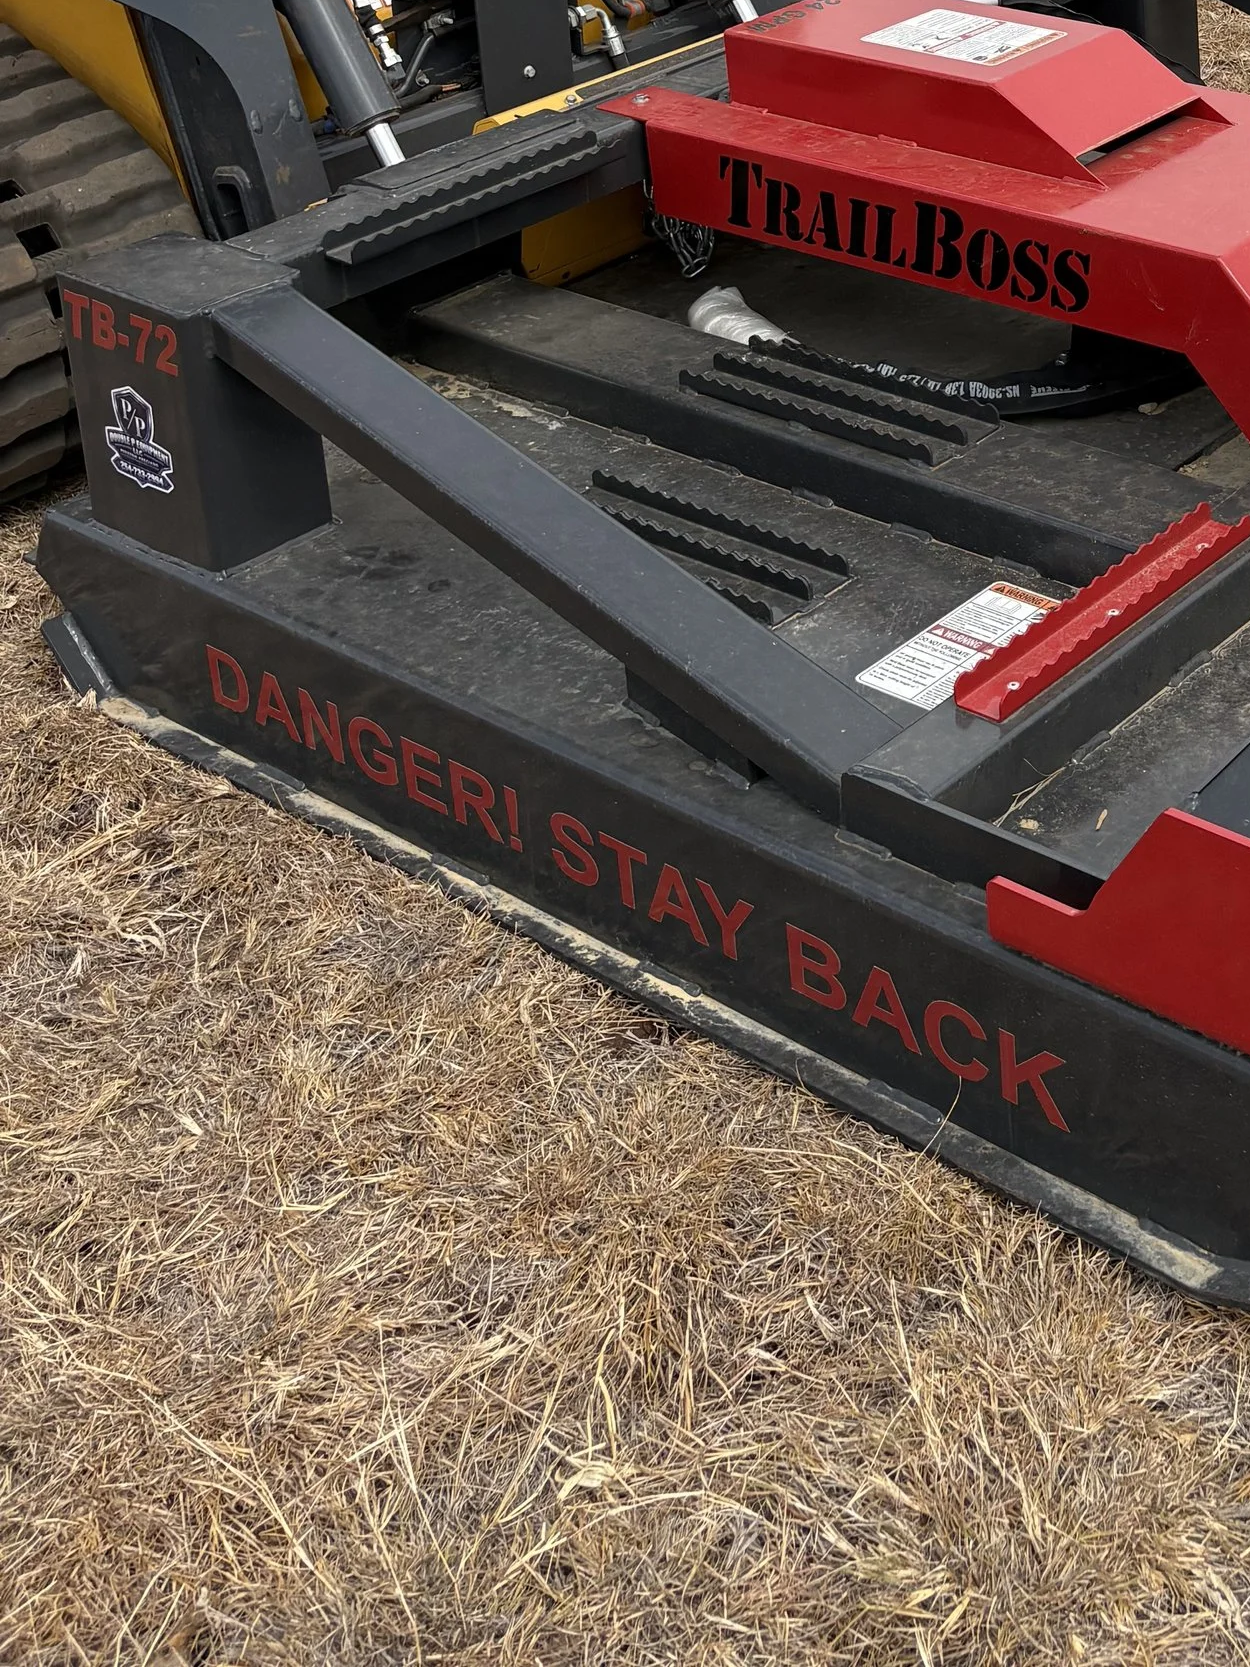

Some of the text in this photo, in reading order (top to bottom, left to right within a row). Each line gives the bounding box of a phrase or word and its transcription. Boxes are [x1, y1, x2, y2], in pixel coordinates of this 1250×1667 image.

[63, 289, 179, 378] TB-72
[1004, 587, 1044, 606] WARNING
[929, 639, 943, 647] NOT
[941, 644, 971, 659] OPERATE
[943, 630, 983, 649] WARNING
[205, 643, 1072, 1134] DANGER! STAY BACK
